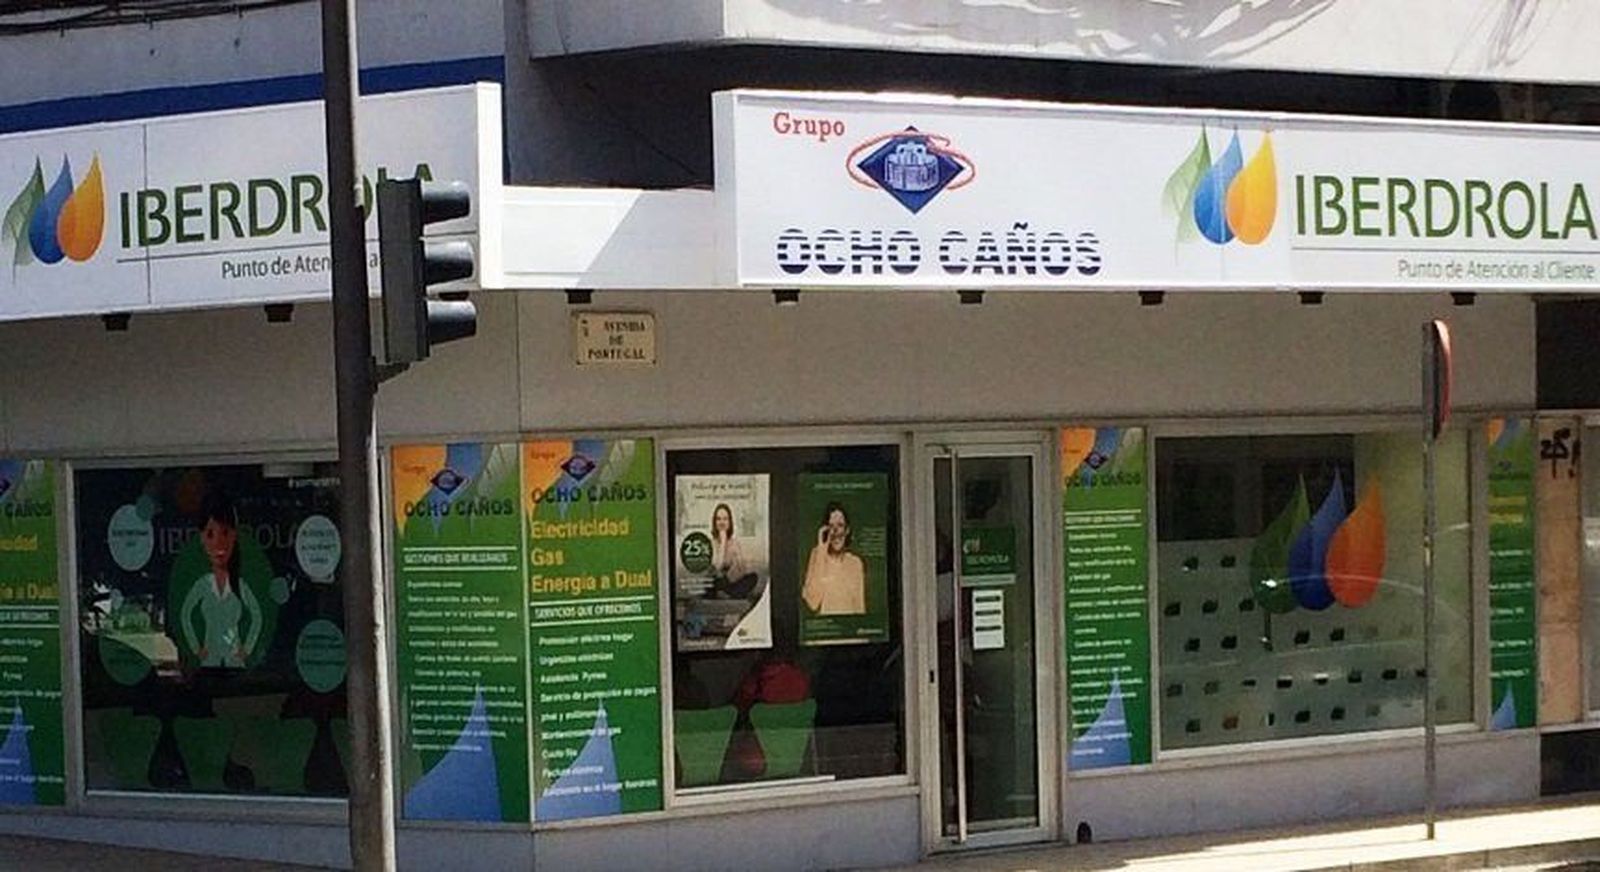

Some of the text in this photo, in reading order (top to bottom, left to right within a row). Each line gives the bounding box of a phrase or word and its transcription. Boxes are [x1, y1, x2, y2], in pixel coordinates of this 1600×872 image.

[773, 112, 845, 142] Grupo
[1295, 174, 1597, 240] IBERDROLA
[776, 221, 1101, 276] OCHO CAÑOS
[222, 262, 269, 279] Punto
[271, 256, 291, 275] de
[1398, 260, 1442, 278] Punto
[1445, 261, 1463, 279] de
[1532, 261, 1544, 279] al
[1547, 261, 1595, 280] Cliente
[532, 481, 646, 504] OCHO CAÑOS
[404, 501, 451, 517] OCHO
[531, 517, 629, 539] Electricidad
[531, 548, 565, 567] Gas
[614, 568, 653, 588] Dual
